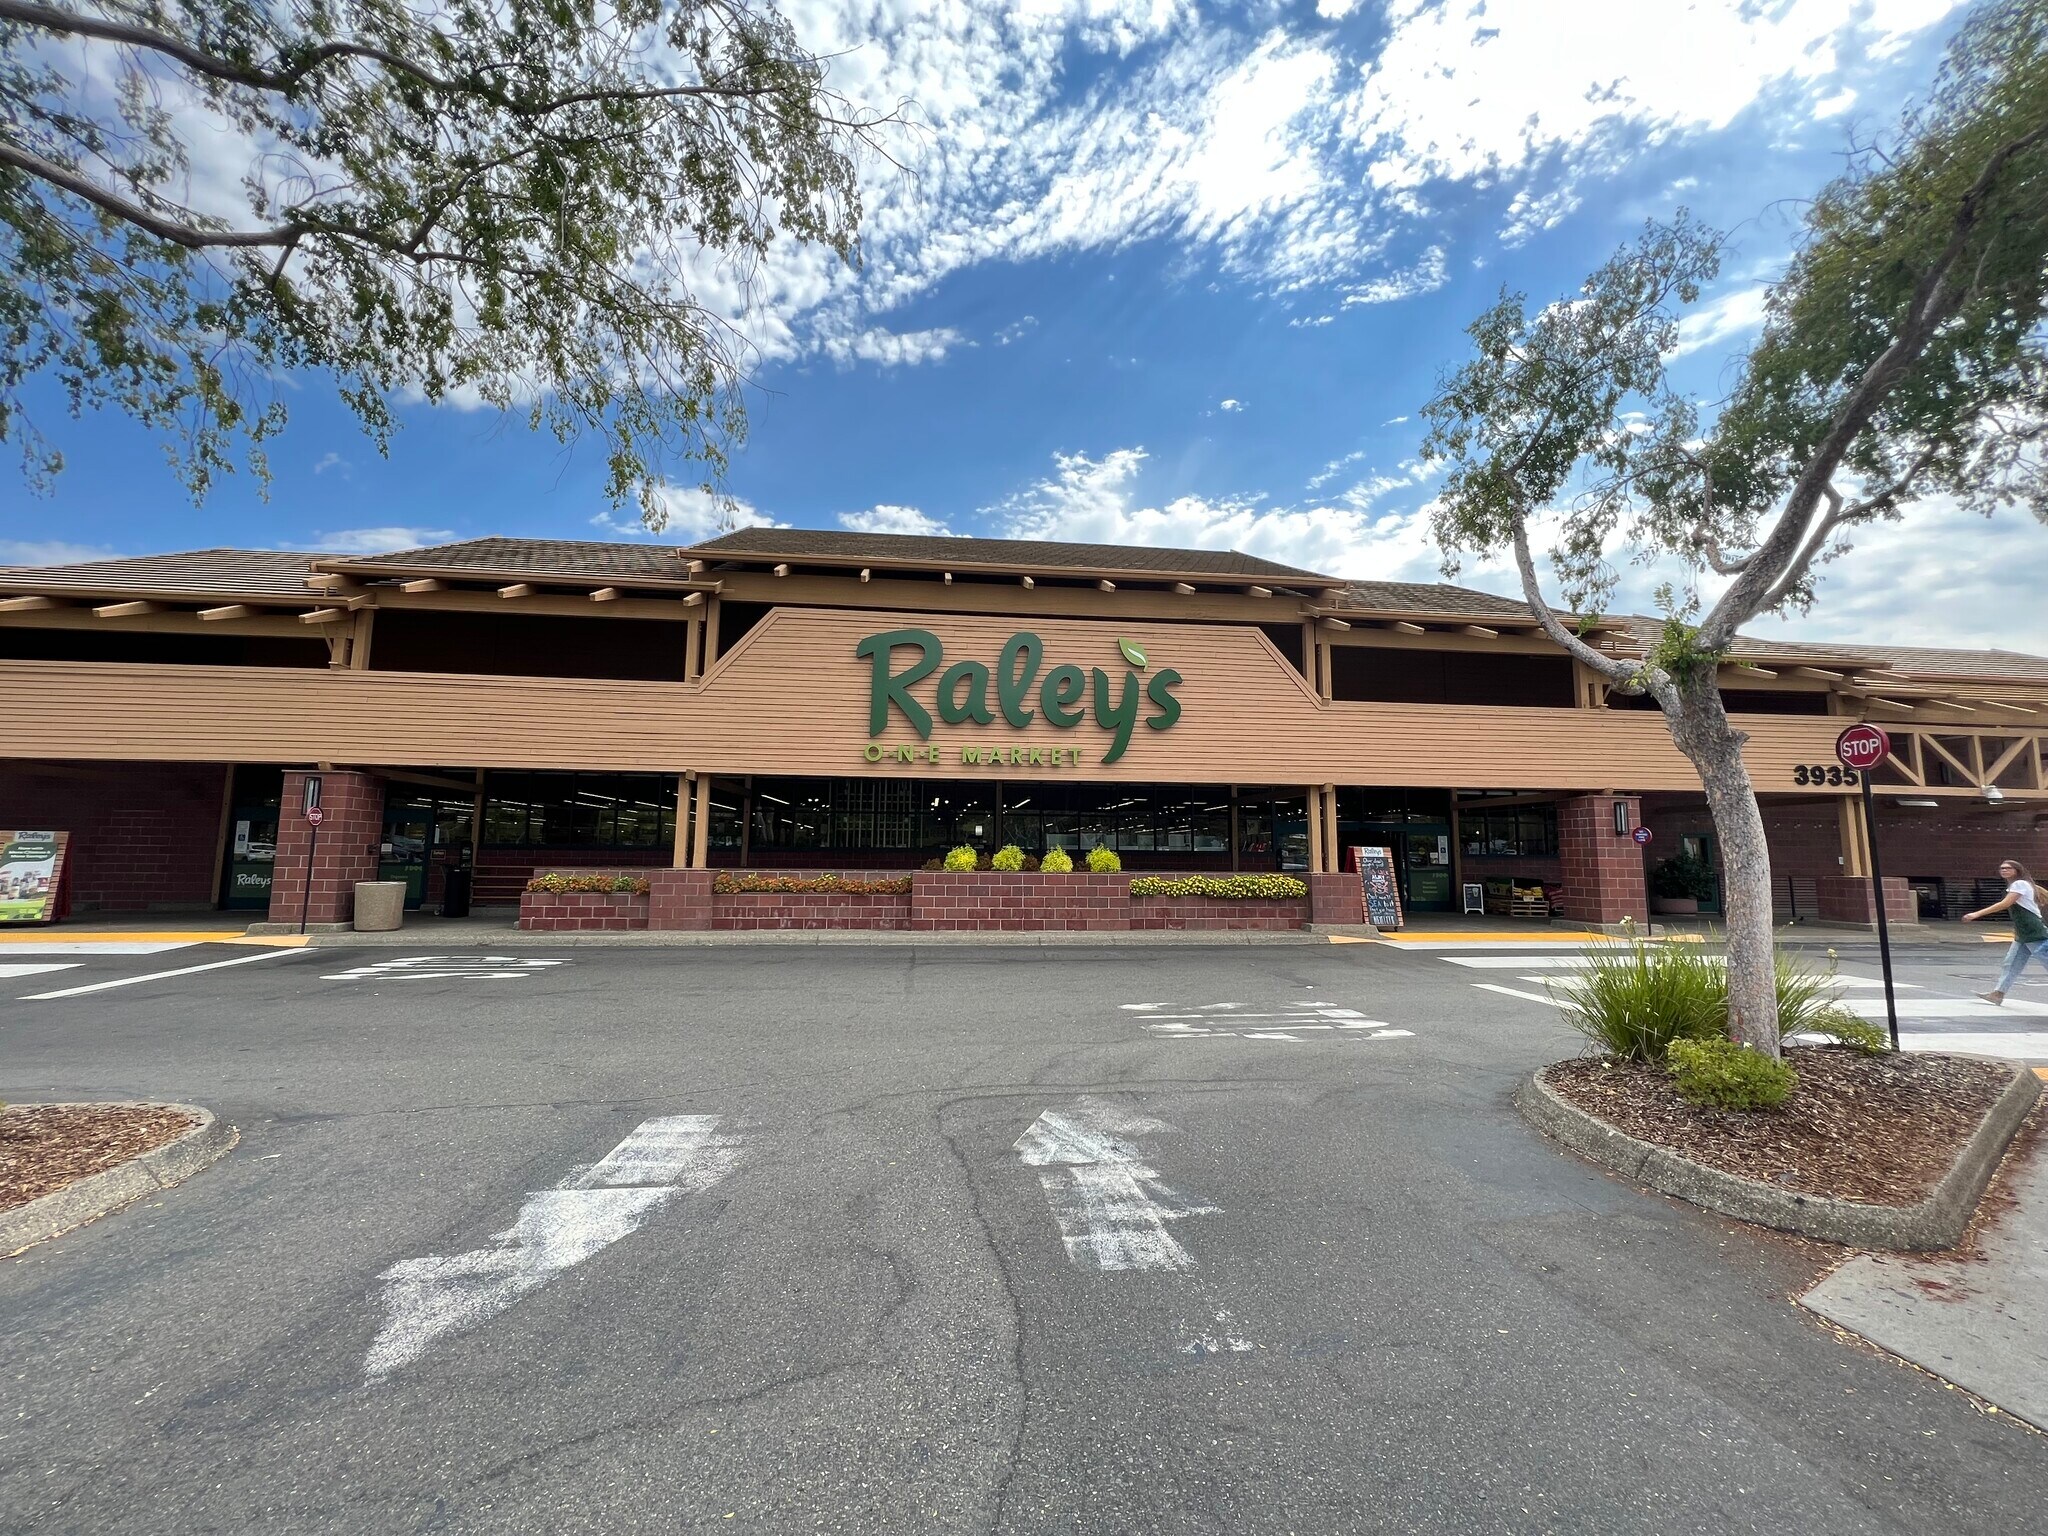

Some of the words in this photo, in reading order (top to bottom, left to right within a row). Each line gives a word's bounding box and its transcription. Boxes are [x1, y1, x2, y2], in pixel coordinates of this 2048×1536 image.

[961, 745, 1083, 767] MARKET
[1842, 738, 1879, 757] STOP
[1793, 764, 1859, 786] 3935
[308, 813, 323, 821] STOP
